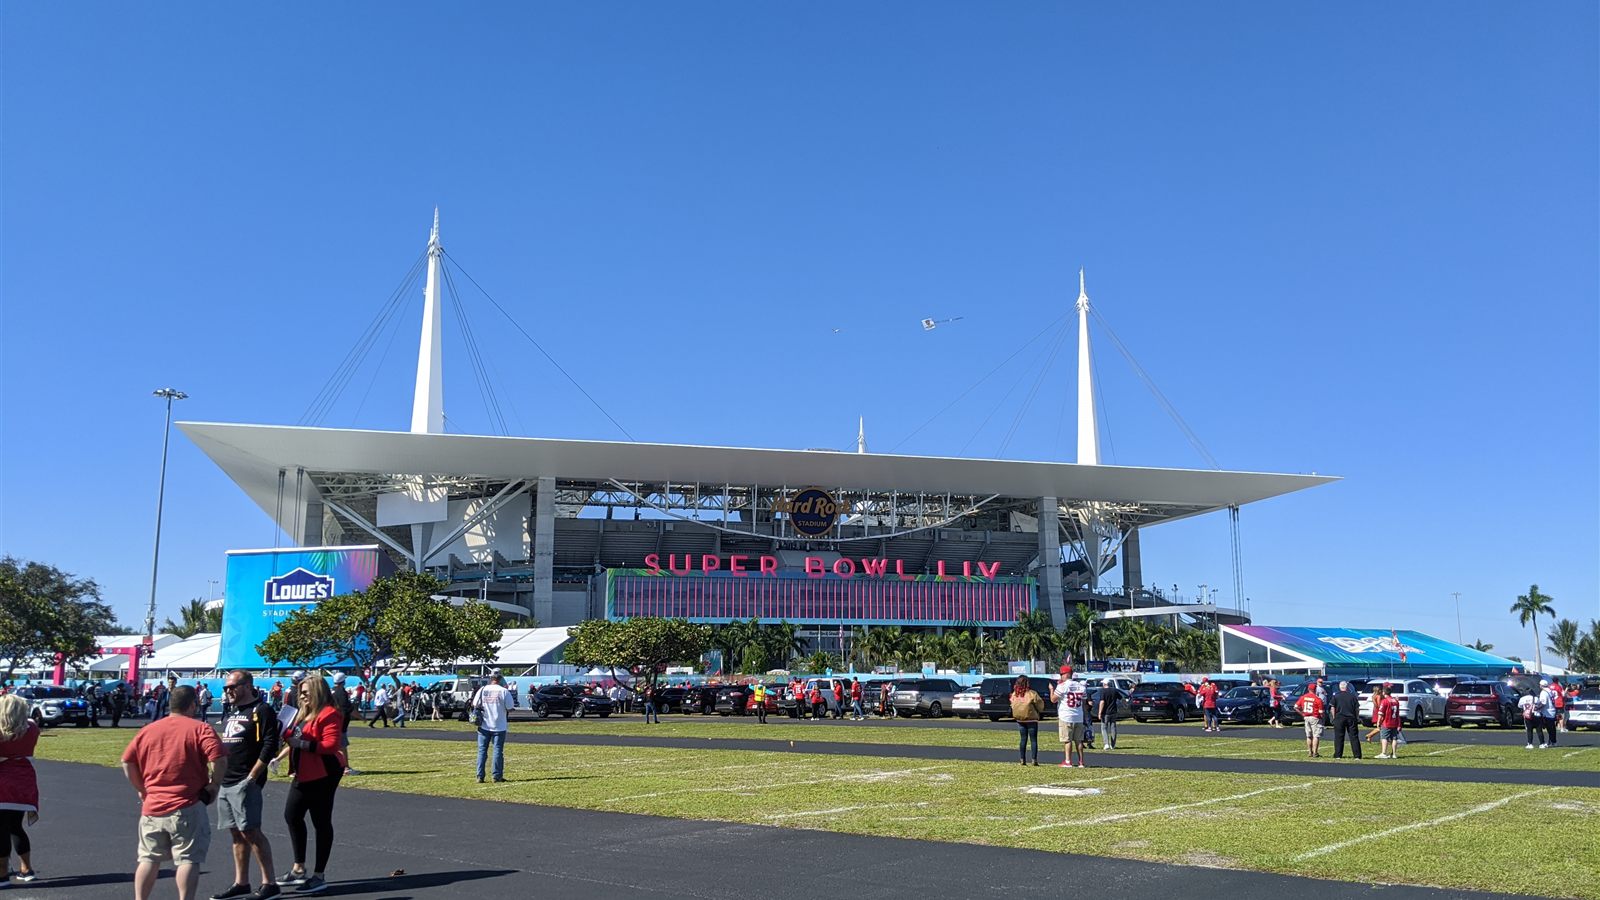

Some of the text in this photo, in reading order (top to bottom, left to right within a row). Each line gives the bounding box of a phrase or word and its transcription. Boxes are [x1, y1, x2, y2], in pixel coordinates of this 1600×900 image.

[770, 495, 850, 518] Hard Rock
[644, 553, 1001, 582] SUPER BOWL LIV
[271, 581, 329, 600] LOWE'S
[1067, 692, 1083, 708] 85
[1303, 701, 1314, 713] 15
